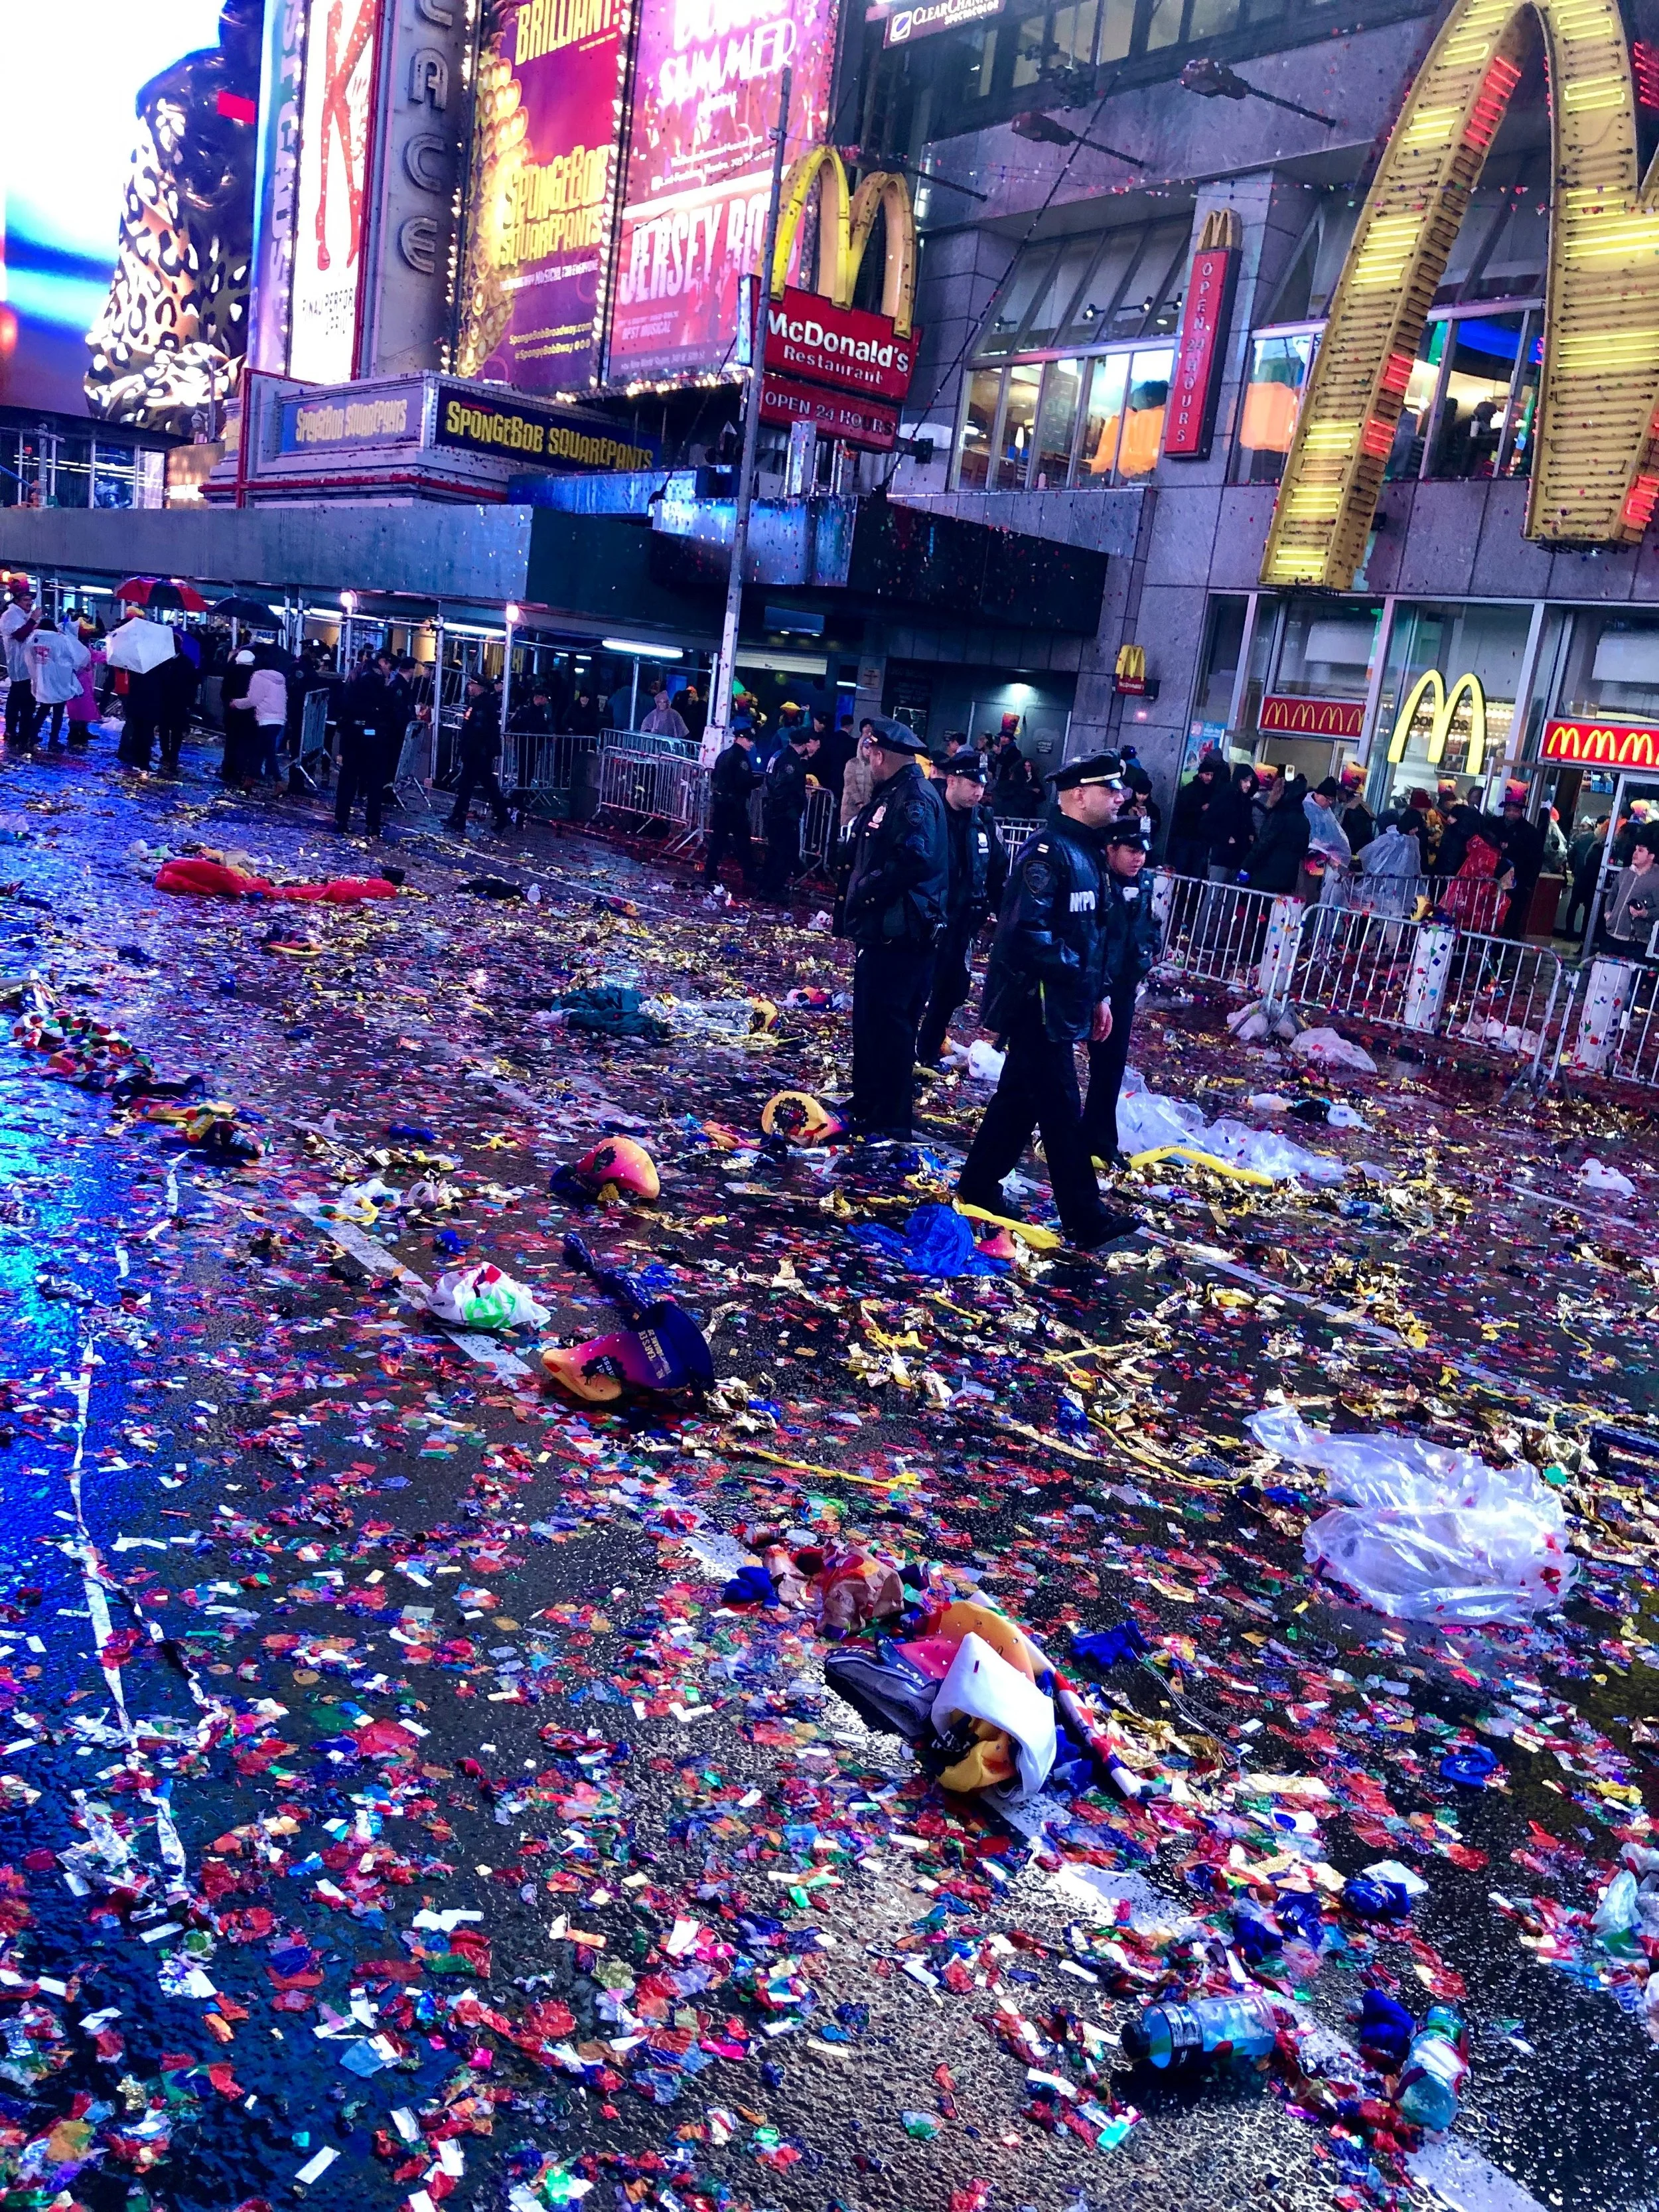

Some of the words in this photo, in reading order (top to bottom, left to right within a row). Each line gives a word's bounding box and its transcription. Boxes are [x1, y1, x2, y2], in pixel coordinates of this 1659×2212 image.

[656, 18, 798, 108] SUMMER
[504, 144, 610, 226] SPONGEBOB
[499, 203, 604, 267] SQUAREPANTS
[619, 203, 723, 305] JERSEY
[1194, 261, 1214, 331] OPEN
[767, 309, 910, 373] McDonald's
[783, 344, 883, 384] Restaurant
[1186, 336, 1206, 353] 24
[296, 405, 344, 442] SPONGEBOB
[345, 399, 407, 437] SQUAREPANTS
[765, 391, 810, 414] OPEN
[816, 405, 834, 420] 24
[839, 409, 897, 436] HOURS
[1177, 356, 1196, 443] HOURS
[446, 400, 544, 453] SPONGEBOB
[548, 426, 654, 469] SQUAREPANTS
